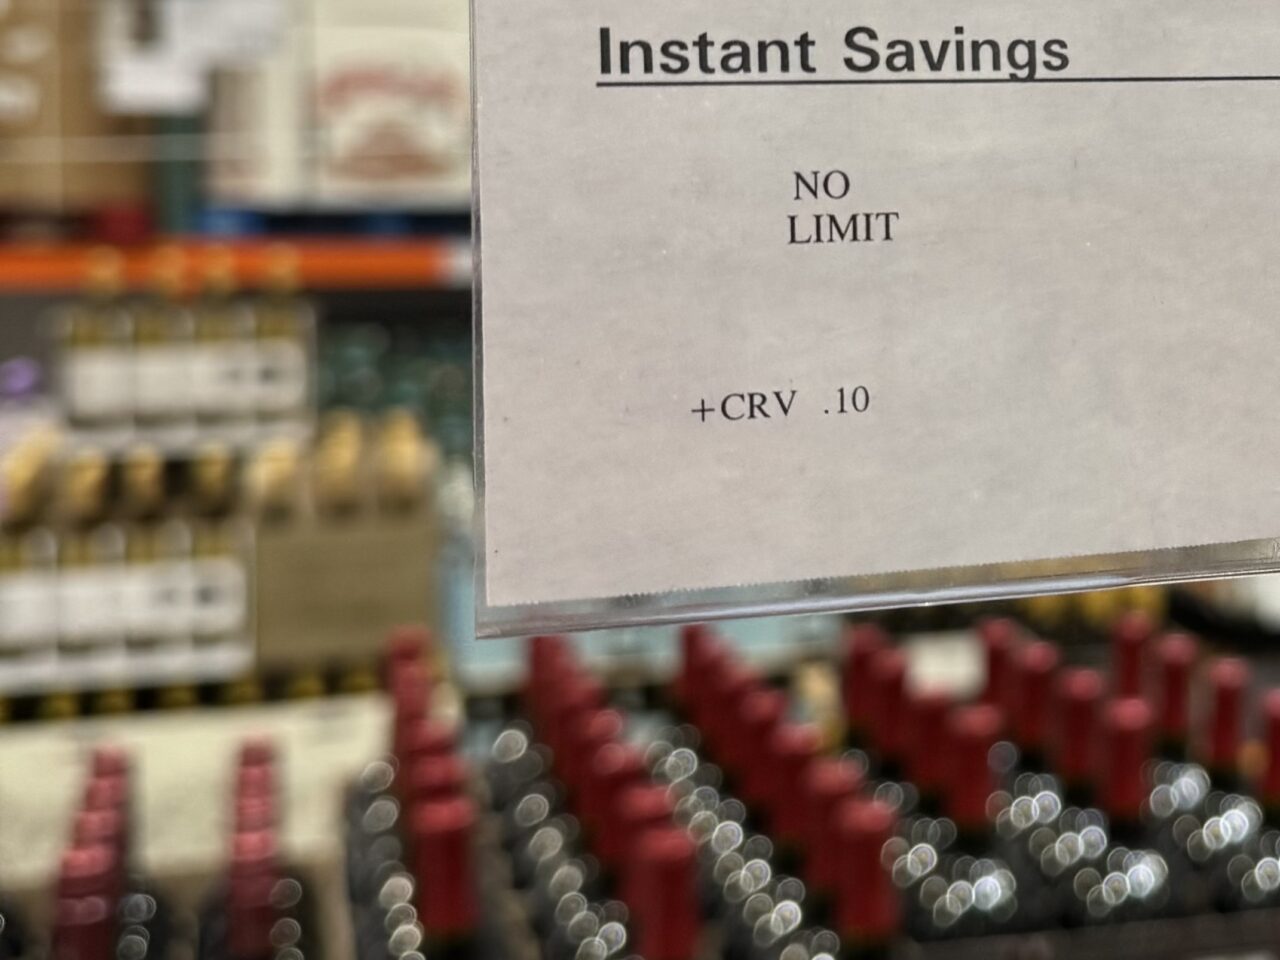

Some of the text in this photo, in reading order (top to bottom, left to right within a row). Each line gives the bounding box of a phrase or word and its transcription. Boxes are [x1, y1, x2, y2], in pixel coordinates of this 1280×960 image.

[599, 26, 1070, 81] Instant Savings
[793, 170, 851, 201] NO
[787, 211, 901, 245] LIMIT
[691, 385, 870, 423] +CRV .10
